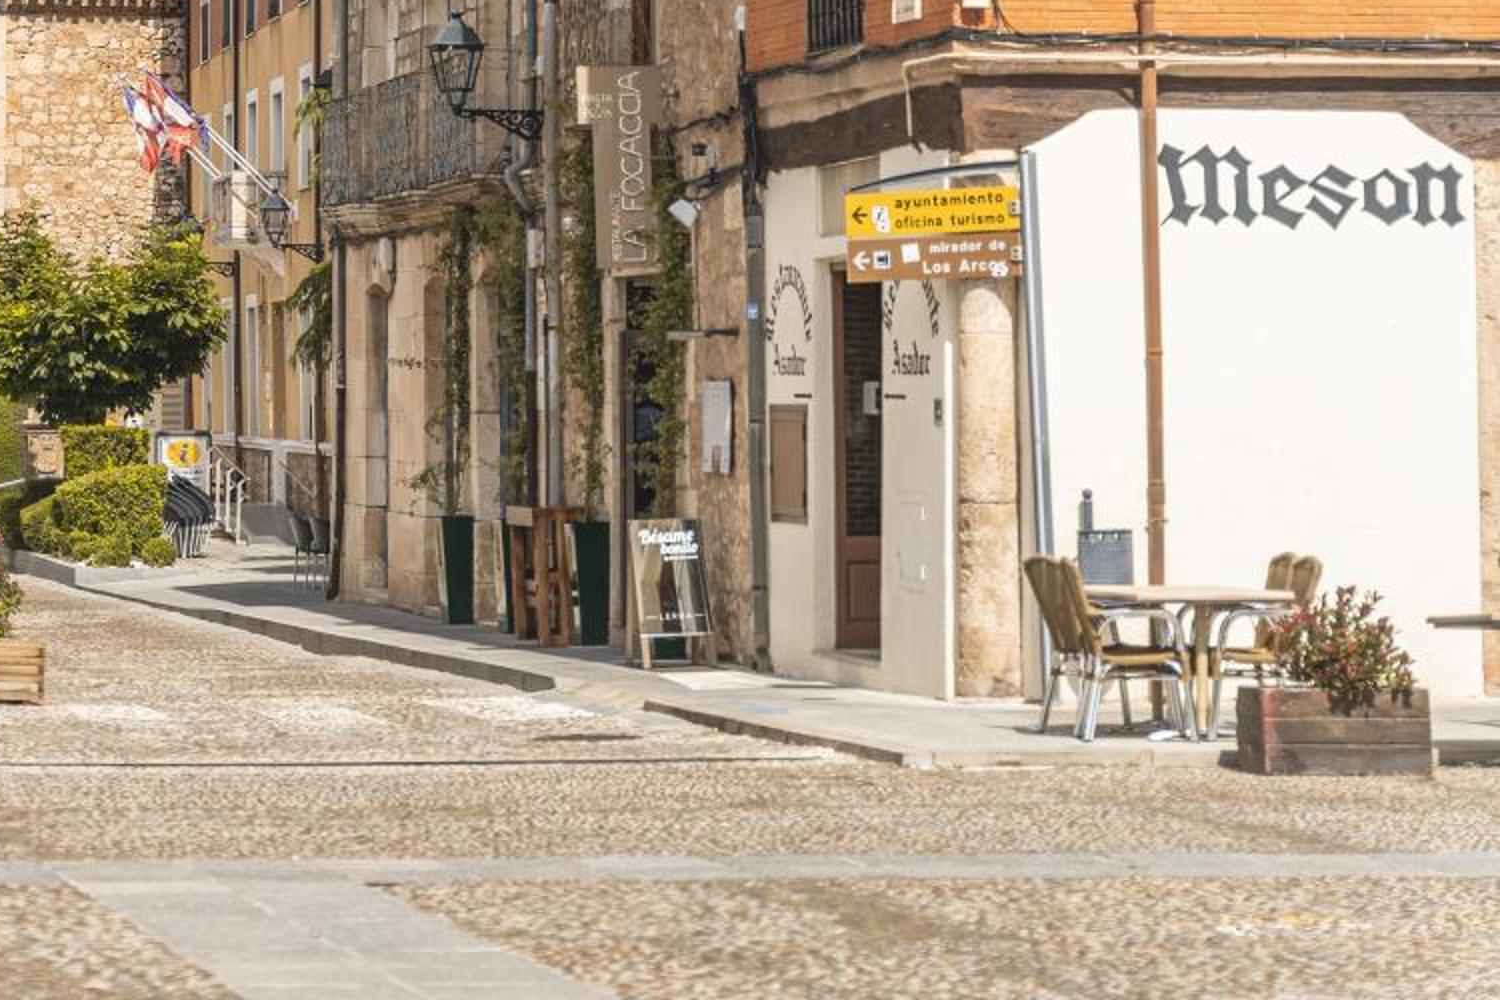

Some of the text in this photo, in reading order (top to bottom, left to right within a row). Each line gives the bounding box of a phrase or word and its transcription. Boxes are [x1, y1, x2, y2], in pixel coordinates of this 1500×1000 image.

[616, 70, 647, 263] LA FOCACCIA
[895, 192, 1004, 210] ayuntamiento
[895, 213, 1005, 229] oficina turismo
[929, 239, 1007, 254] mirador de
[921, 259, 951, 275] Los
